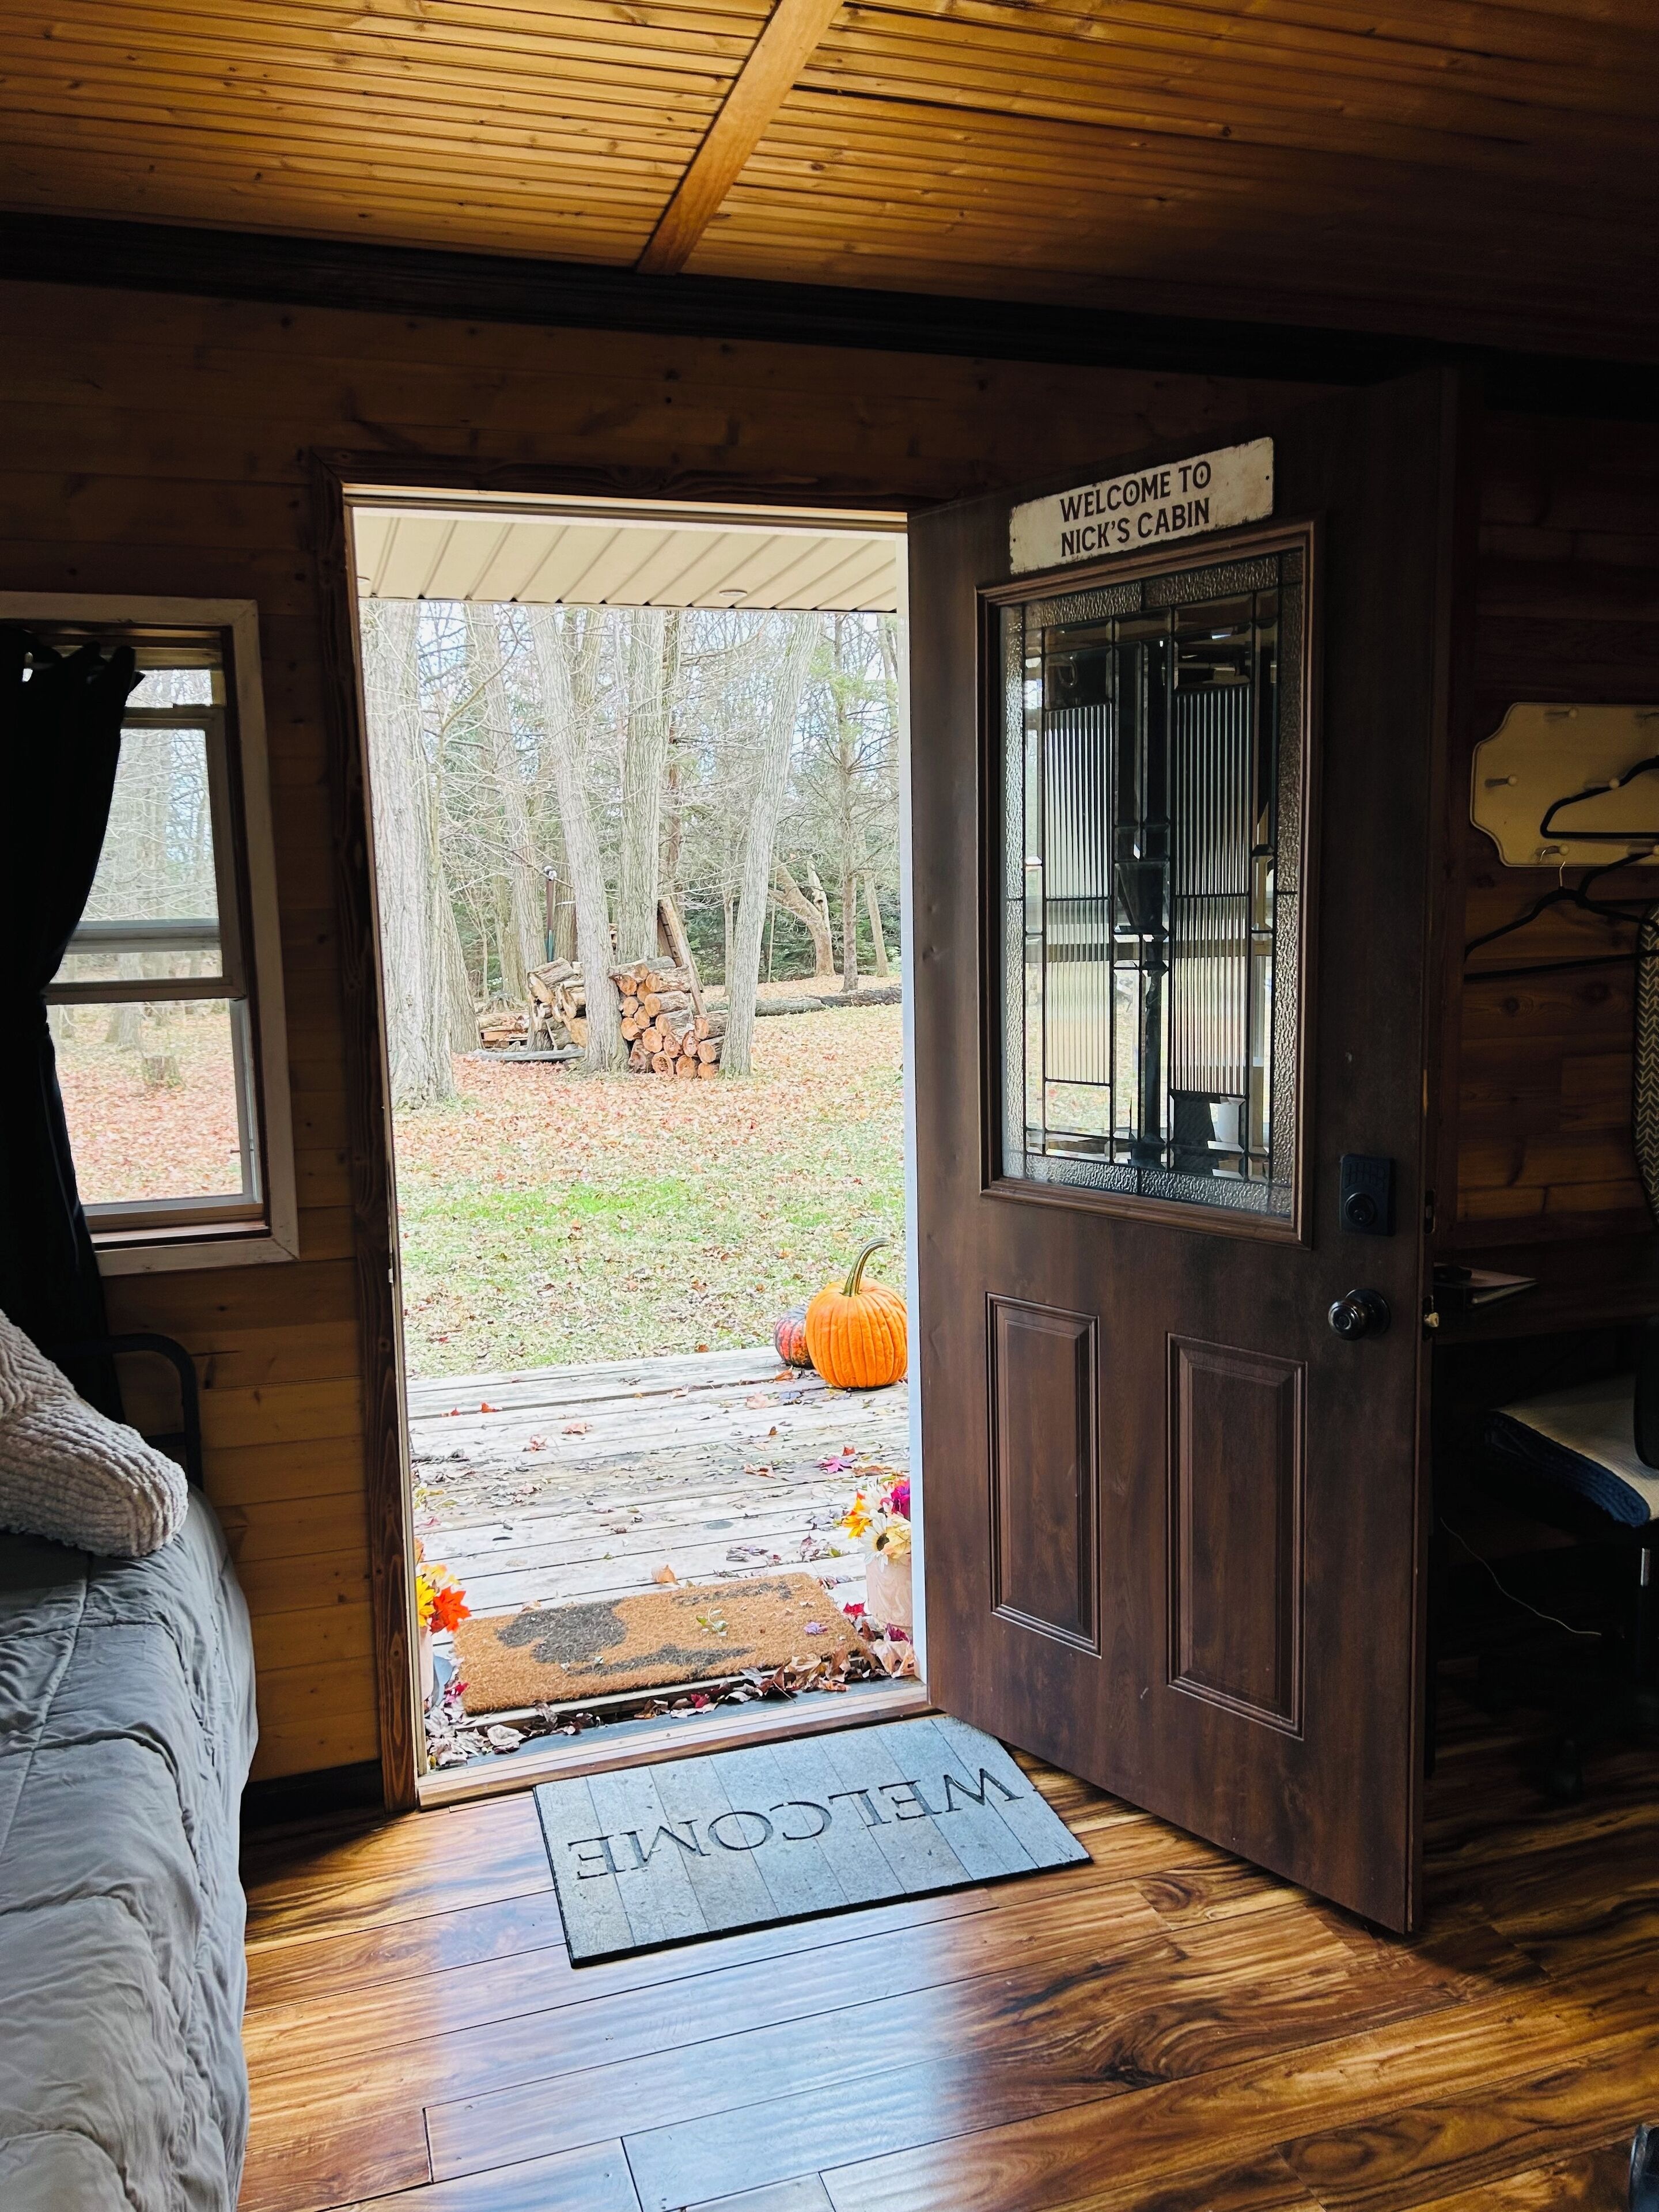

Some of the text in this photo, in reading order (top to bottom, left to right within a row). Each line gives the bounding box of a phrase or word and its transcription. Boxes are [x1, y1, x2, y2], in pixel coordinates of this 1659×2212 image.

[1059, 461, 1211, 522] WELCOME TO
[1061, 498, 1210, 557] NICK'S CABIN
[568, 1768, 1024, 1880] WELCOME
